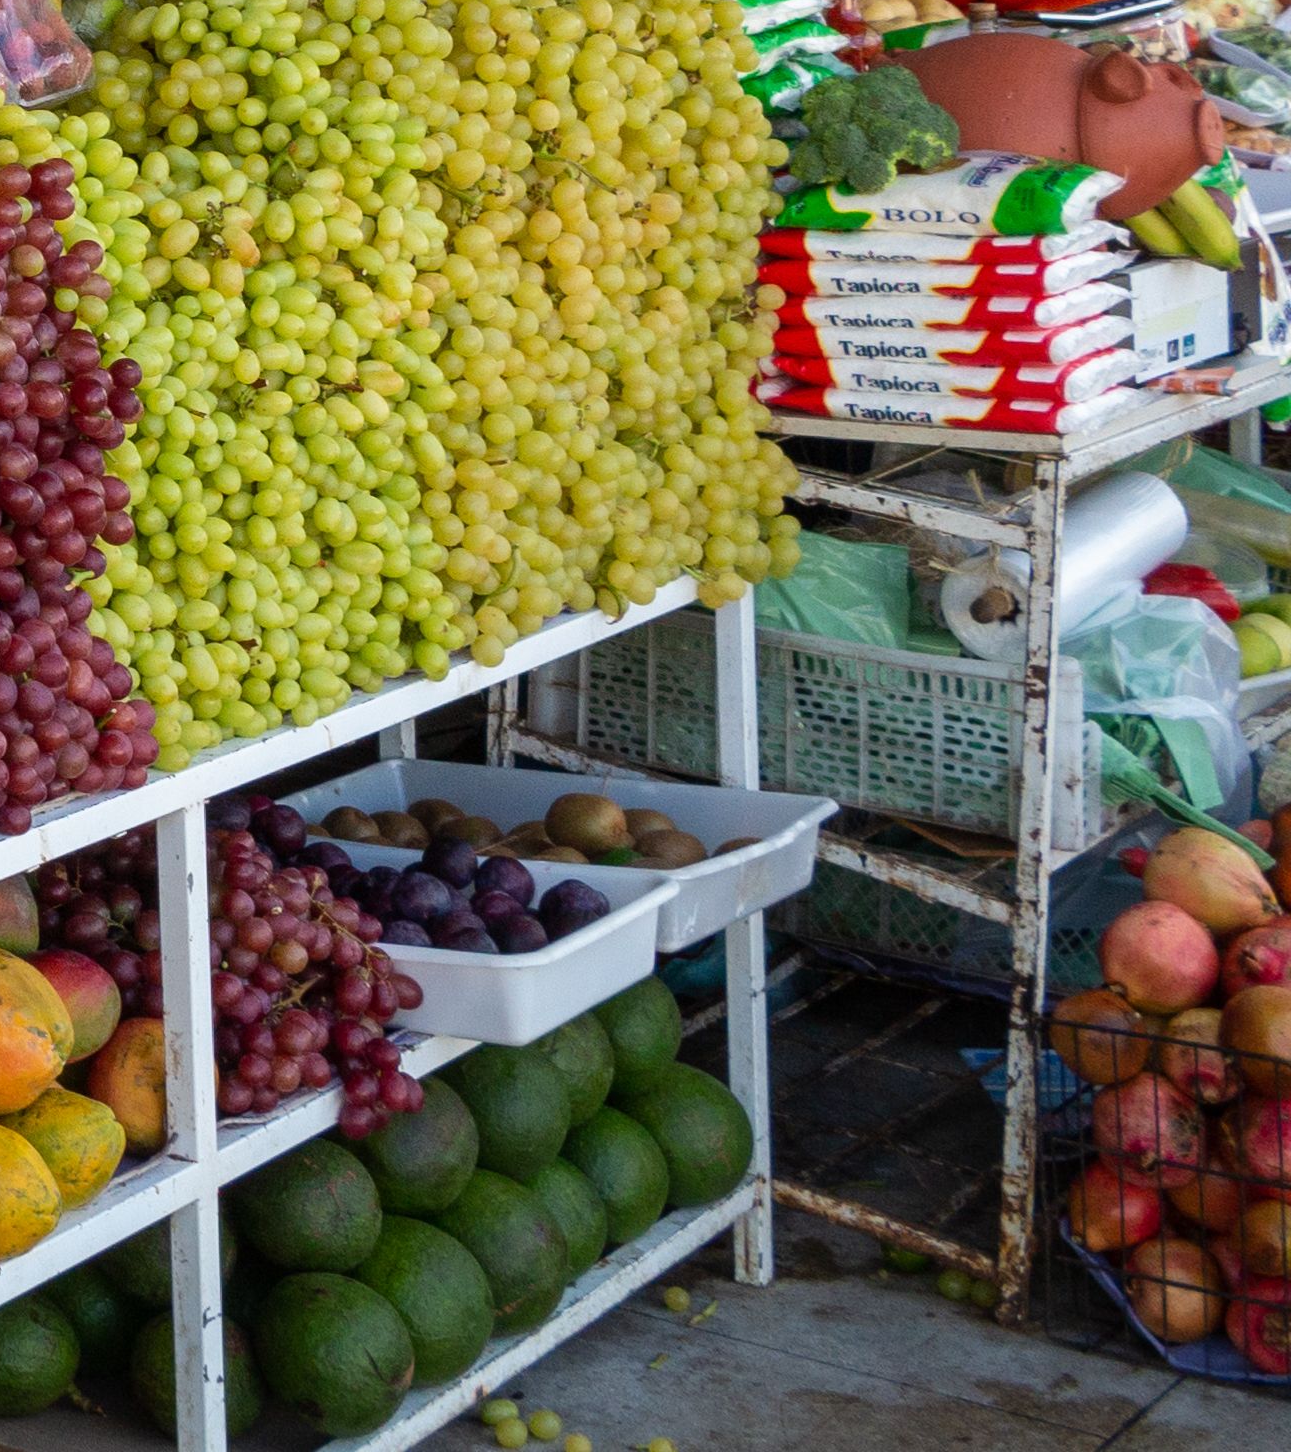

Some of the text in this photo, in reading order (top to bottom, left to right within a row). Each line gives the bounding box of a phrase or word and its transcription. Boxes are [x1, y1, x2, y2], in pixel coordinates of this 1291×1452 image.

[882, 208, 981, 225] BOLO
[831, 277, 921, 294] Tapioca
[824, 313, 915, 328] Tapioca
[838, 340, 927, 359] Tapioca
[852, 373, 941, 393] Tapioca
[844, 403, 933, 424] Tapioca
